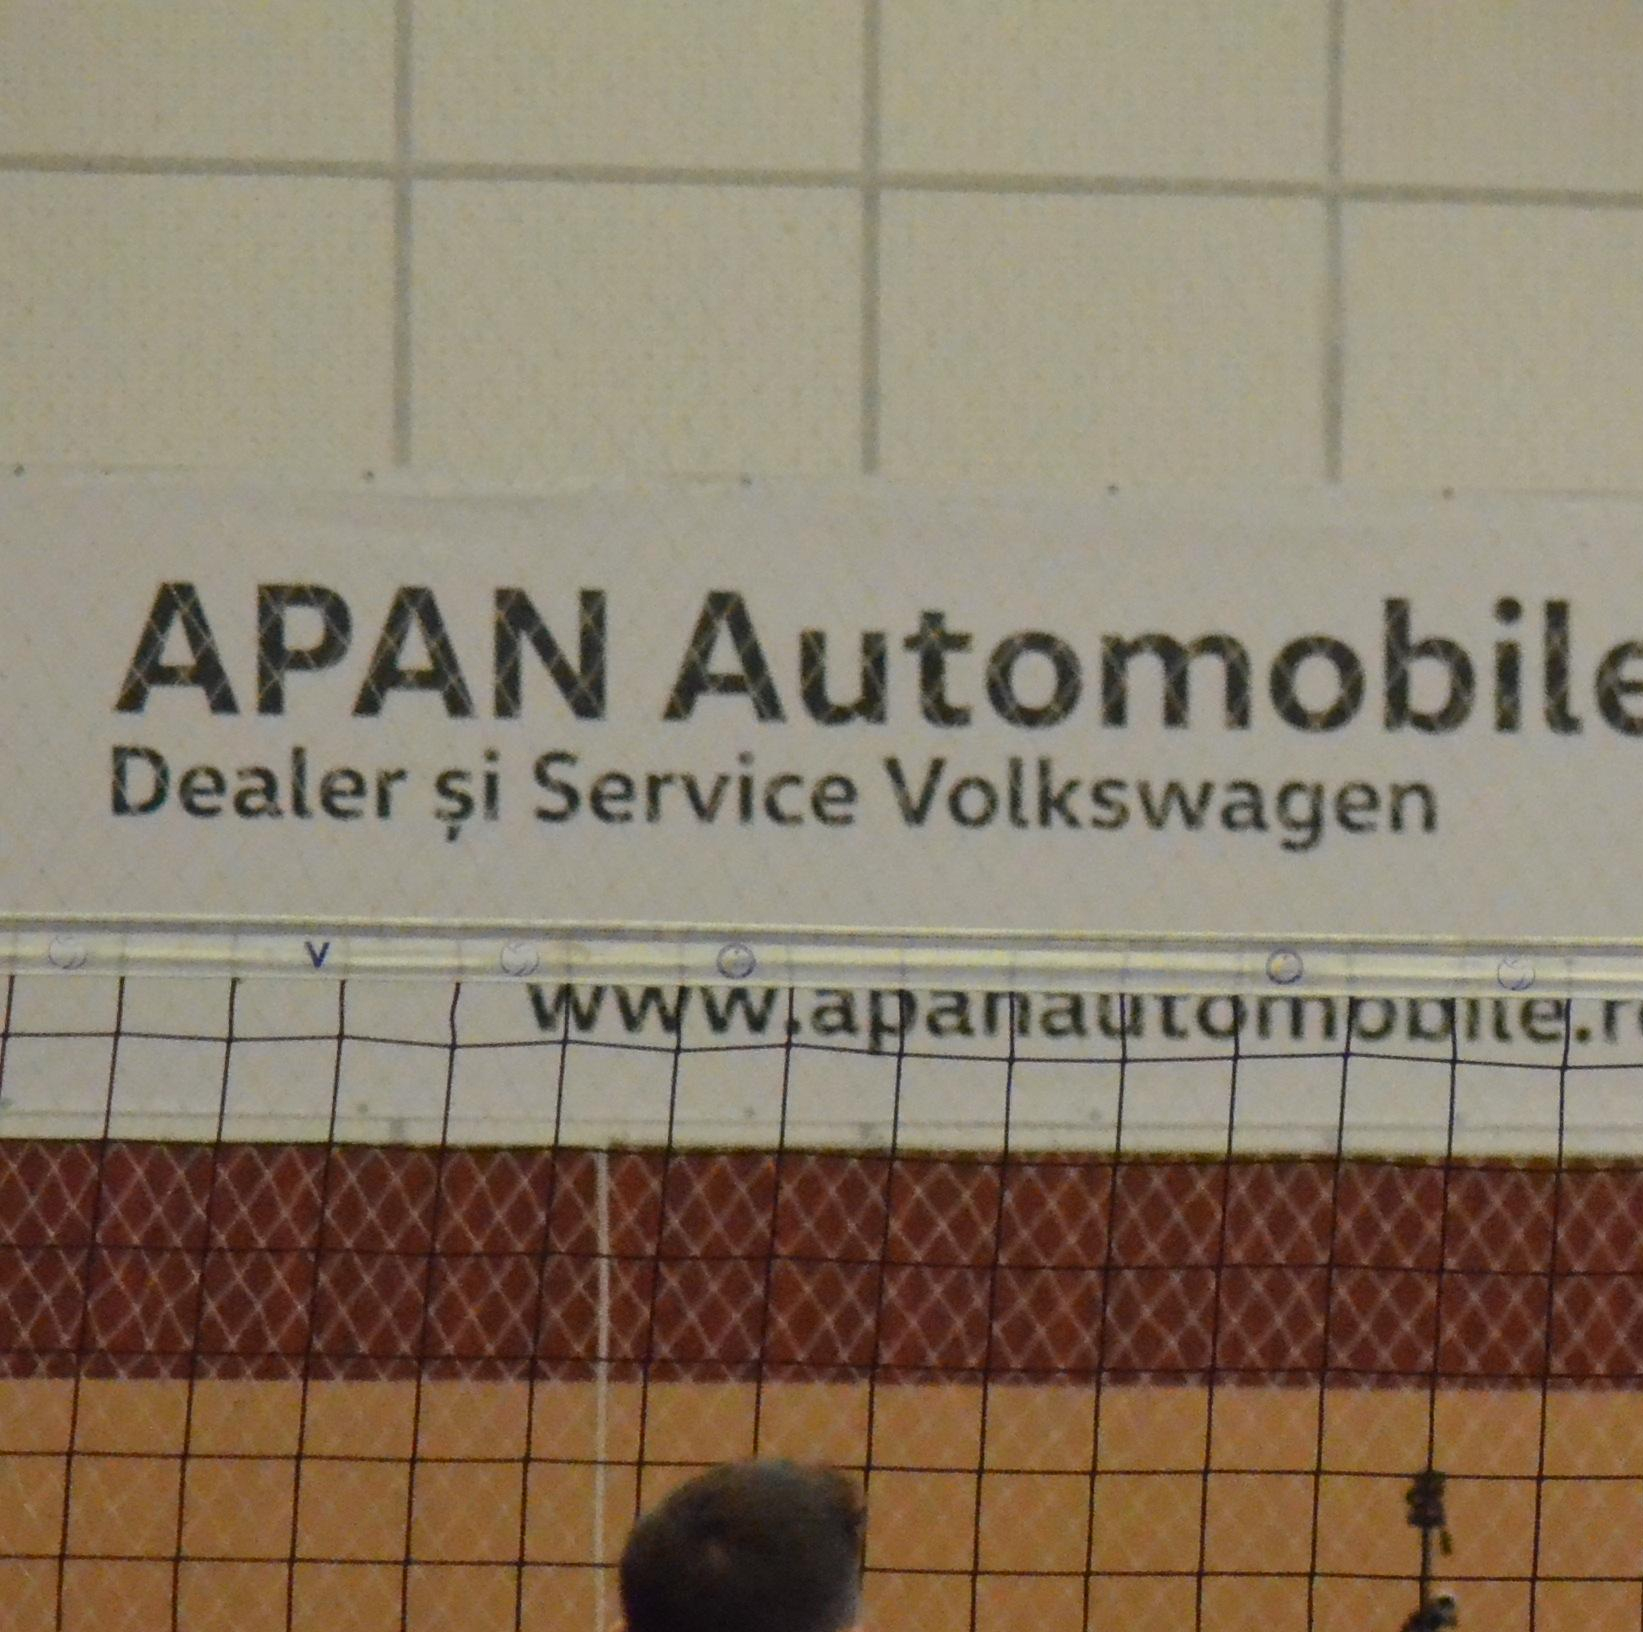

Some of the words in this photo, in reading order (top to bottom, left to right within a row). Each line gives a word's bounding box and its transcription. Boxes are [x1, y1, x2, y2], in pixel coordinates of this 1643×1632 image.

[113, 581, 607, 718] APAN
[111, 745, 407, 821] Dealer
[433, 749, 499, 842] și
[532, 750, 860, 825] Service
[885, 756, 1438, 852] Volkswagen
